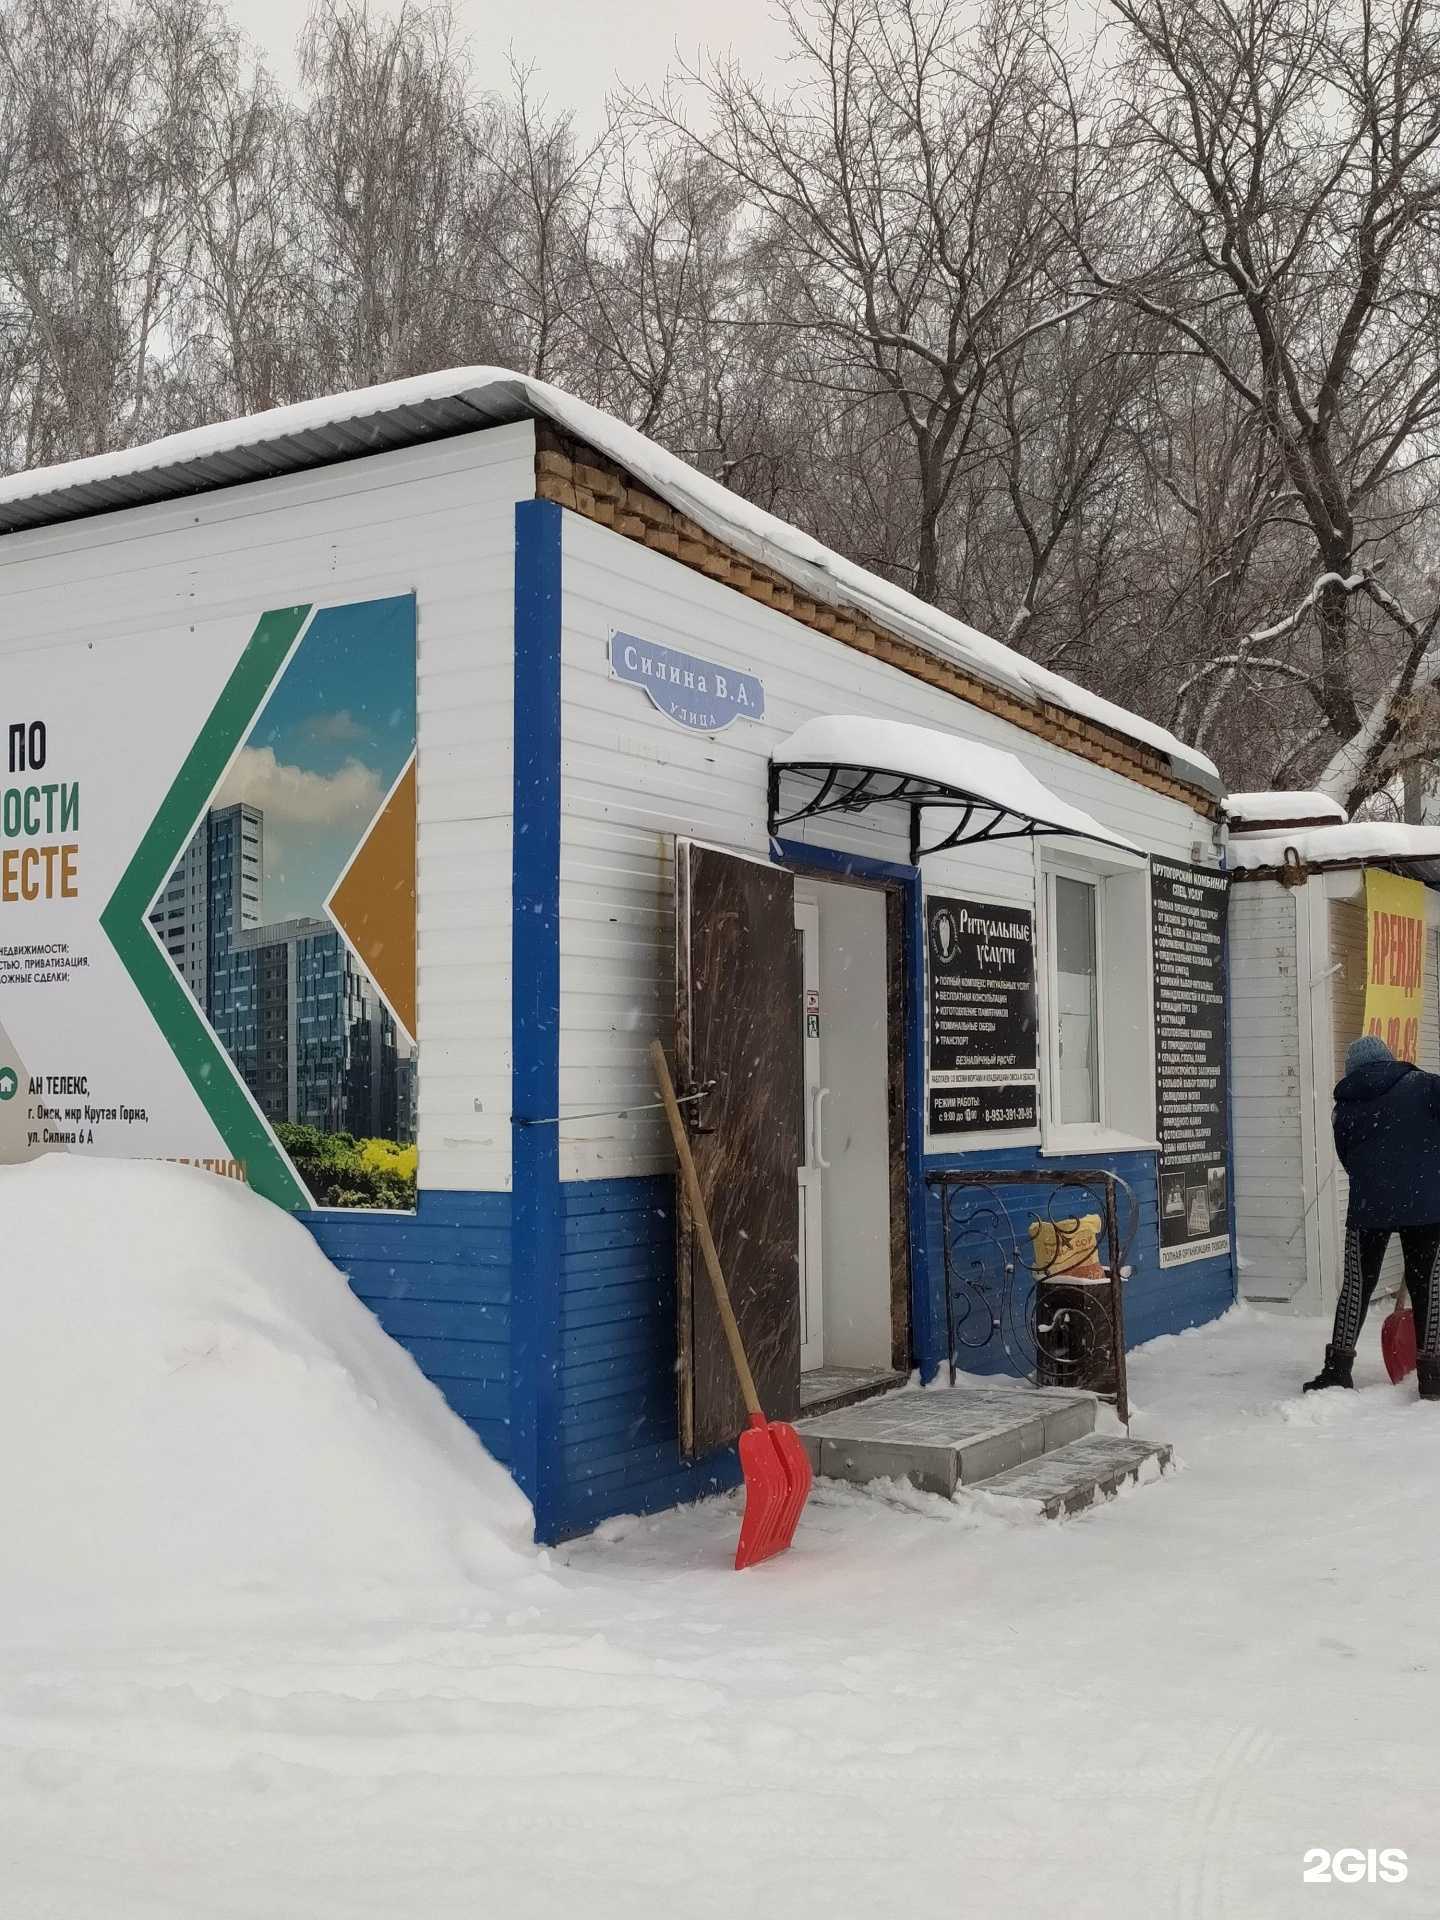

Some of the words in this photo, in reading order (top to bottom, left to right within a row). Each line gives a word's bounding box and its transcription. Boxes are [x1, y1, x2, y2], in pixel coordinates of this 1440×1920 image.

[624, 646, 708, 693] Силина
[9, 720, 46, 773] ПО
[0, 781, 79, 838] ОСТИ
[2, 844, 79, 902] ЕСТЕ
[1371, 911, 1423, 998] АРЕНДА
[28, 1076, 43, 1095] АН
[46, 1075, 90, 1097] ТЕЛЕКС,
[934, 1097, 956, 1108] РЕЖИМ
[27, 1131, 40, 1146] ул.
[43, 1129, 76, 1144] Силина
[79, 1129, 84, 1143] 6
[28, 1107, 34, 1120] г.
[65, 1108, 81, 1123] мкр
[84, 1105, 116, 1124] Крутая
[119, 1105, 149, 1123] Горка,
